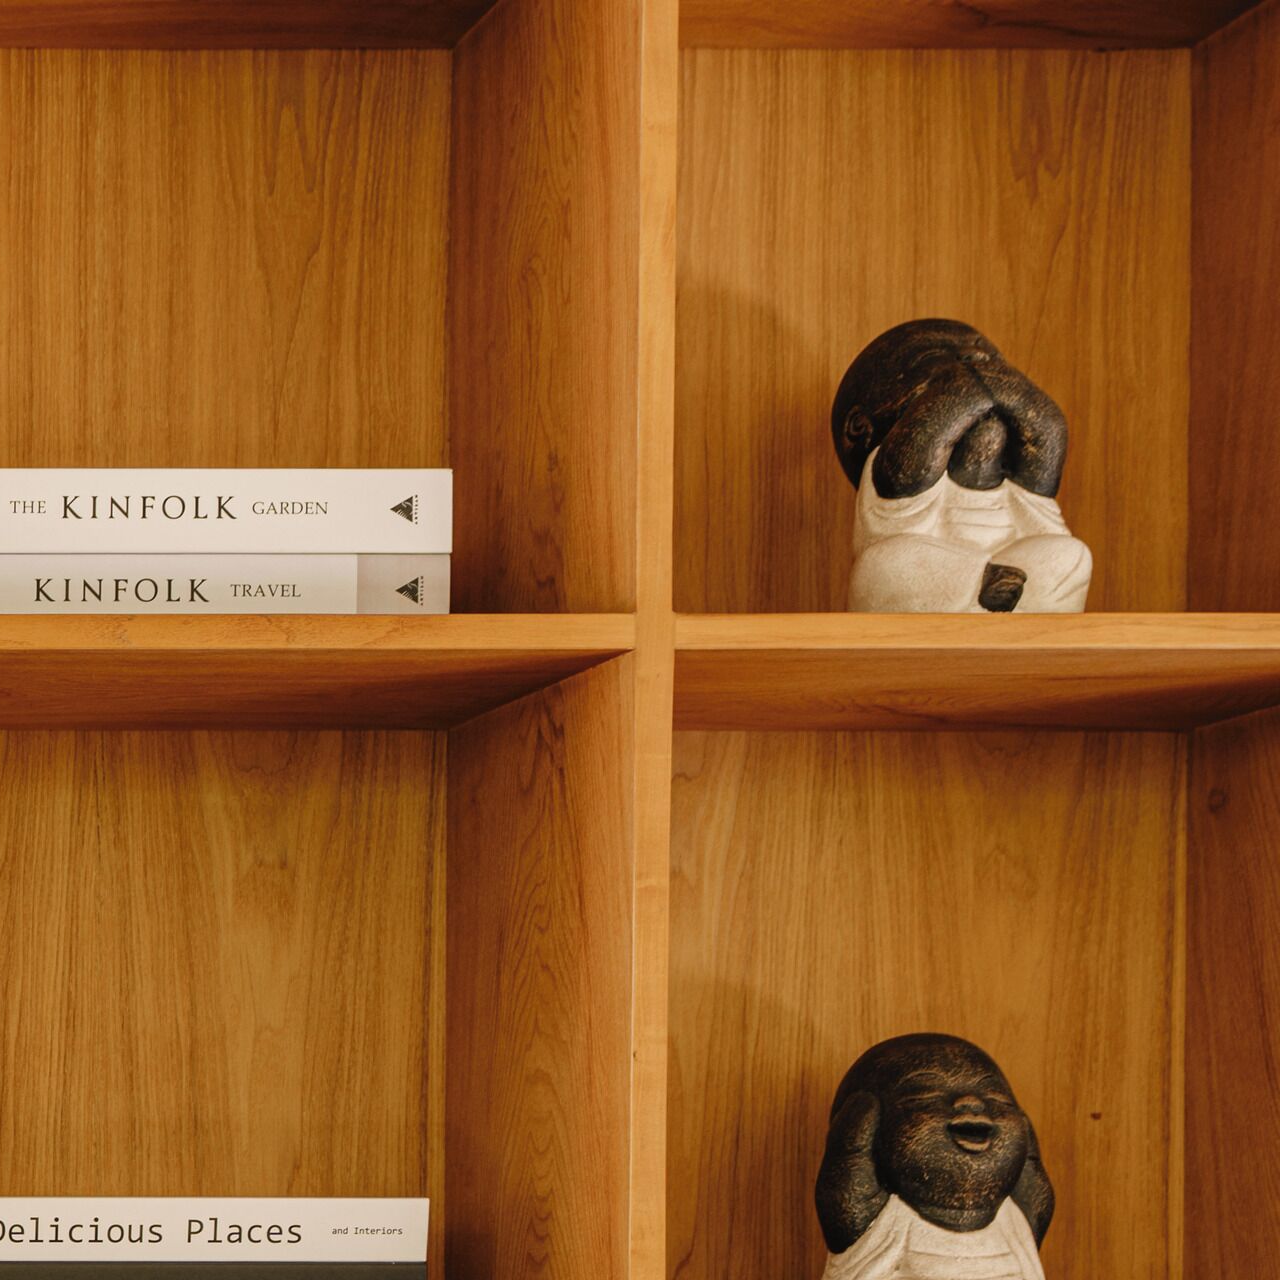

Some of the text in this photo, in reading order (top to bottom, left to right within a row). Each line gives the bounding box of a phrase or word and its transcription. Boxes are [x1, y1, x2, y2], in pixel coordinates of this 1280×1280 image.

[9, 495, 329, 520] THE KINFOLK GARDEN
[34, 578, 302, 603] KINFOLK TRAVEL
[186, 1217, 303, 1244] Places
[331, 1226, 404, 1236] and Interiors
